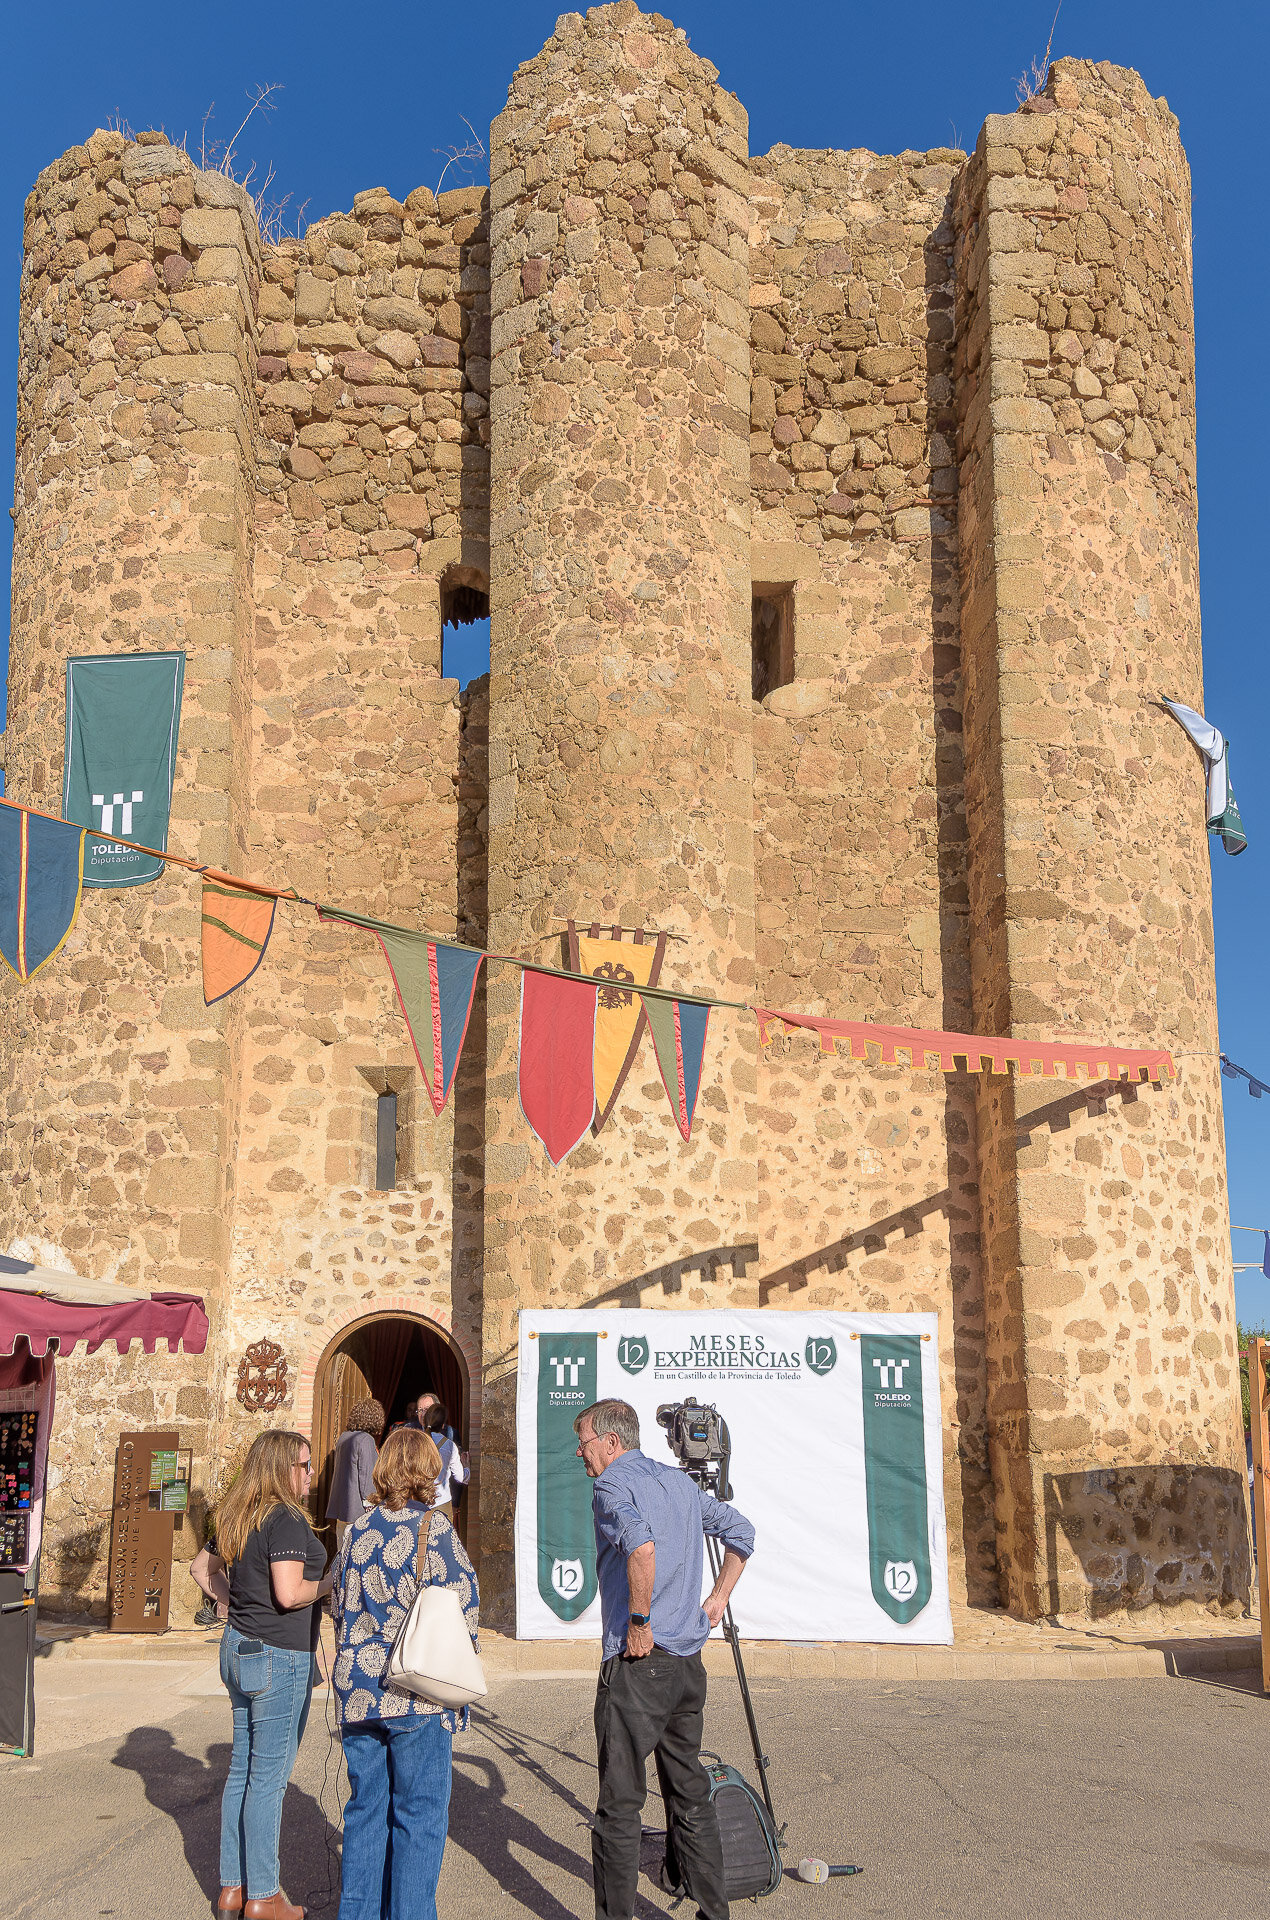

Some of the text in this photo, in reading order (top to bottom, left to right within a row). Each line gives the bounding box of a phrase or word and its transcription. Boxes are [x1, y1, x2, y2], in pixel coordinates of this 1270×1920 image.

[91, 855, 139, 865] Diputación
[619, 1340, 645, 1369] 12
[689, 1335, 765, 1351] MESES
[807, 1340, 833, 1369] 12
[654, 1351, 801, 1368] EXPERIENCIAS
[654, 1371, 665, 1380] En
[677, 1371, 707, 1380] Castillo
[708, 1371, 718, 1380] de
[719, 1371, 726, 1380] la
[727, 1371, 763, 1380] Provincia
[764, 1371, 774, 1380] de
[775, 1371, 802, 1381] Toledo
[873, 1393, 912, 1401] TOLEDO
[113, 1441, 135, 1618] TORREÓN DEL CASTILLO
[128, 1467, 144, 1599] OFICINA DE TURISMO
[555, 1565, 579, 1592] 12
[887, 1566, 912, 1594] 12
